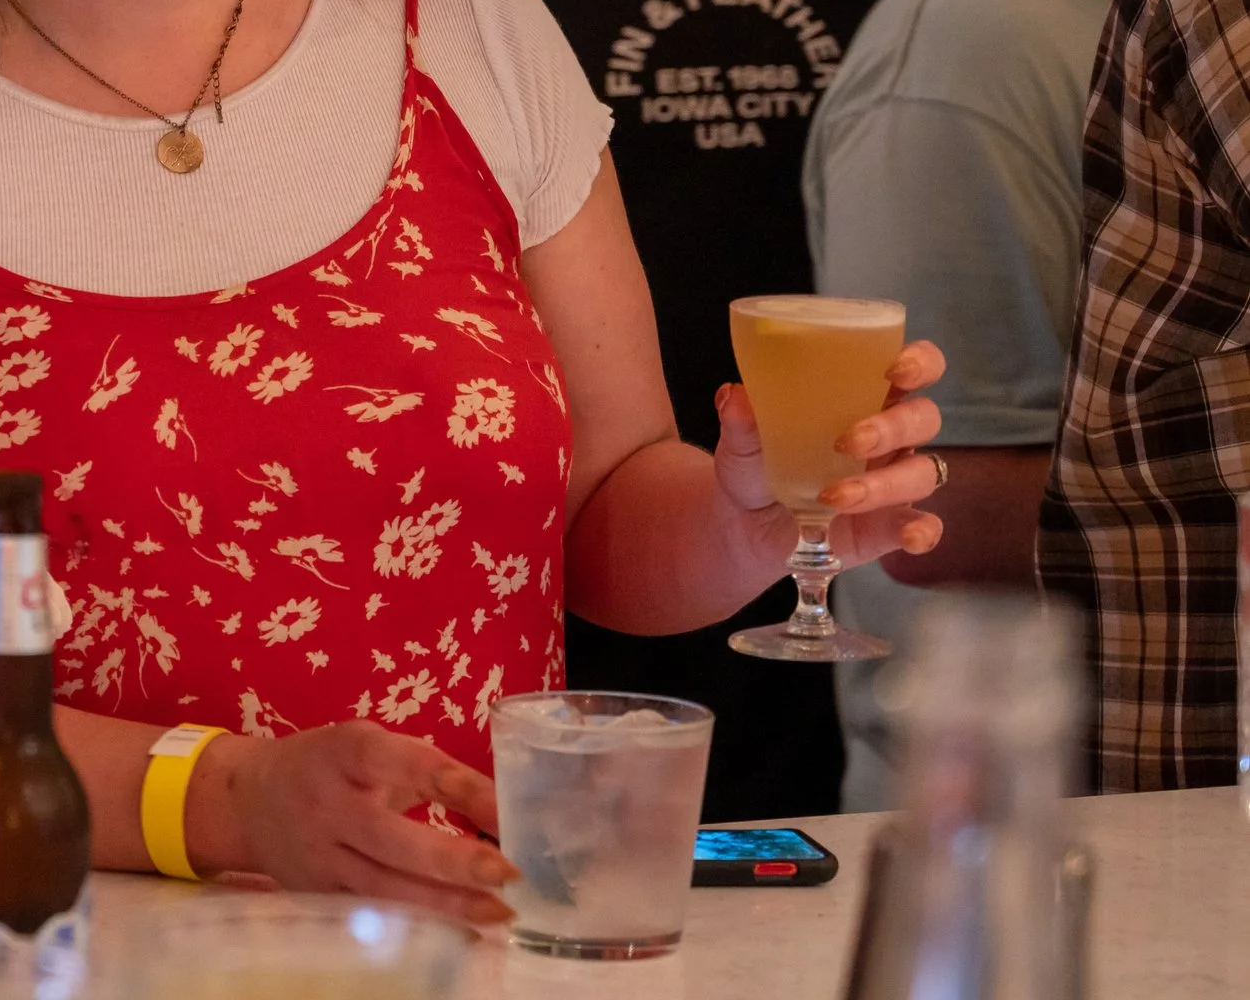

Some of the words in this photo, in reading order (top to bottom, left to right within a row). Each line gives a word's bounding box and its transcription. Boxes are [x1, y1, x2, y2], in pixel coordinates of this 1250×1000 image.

[604, 25, 655, 97] FIN
[655, 66, 724, 93] EST.
[641, 94, 732, 123] IOWA
[735, 92, 814, 118] CITY
[694, 121, 765, 149] USA
